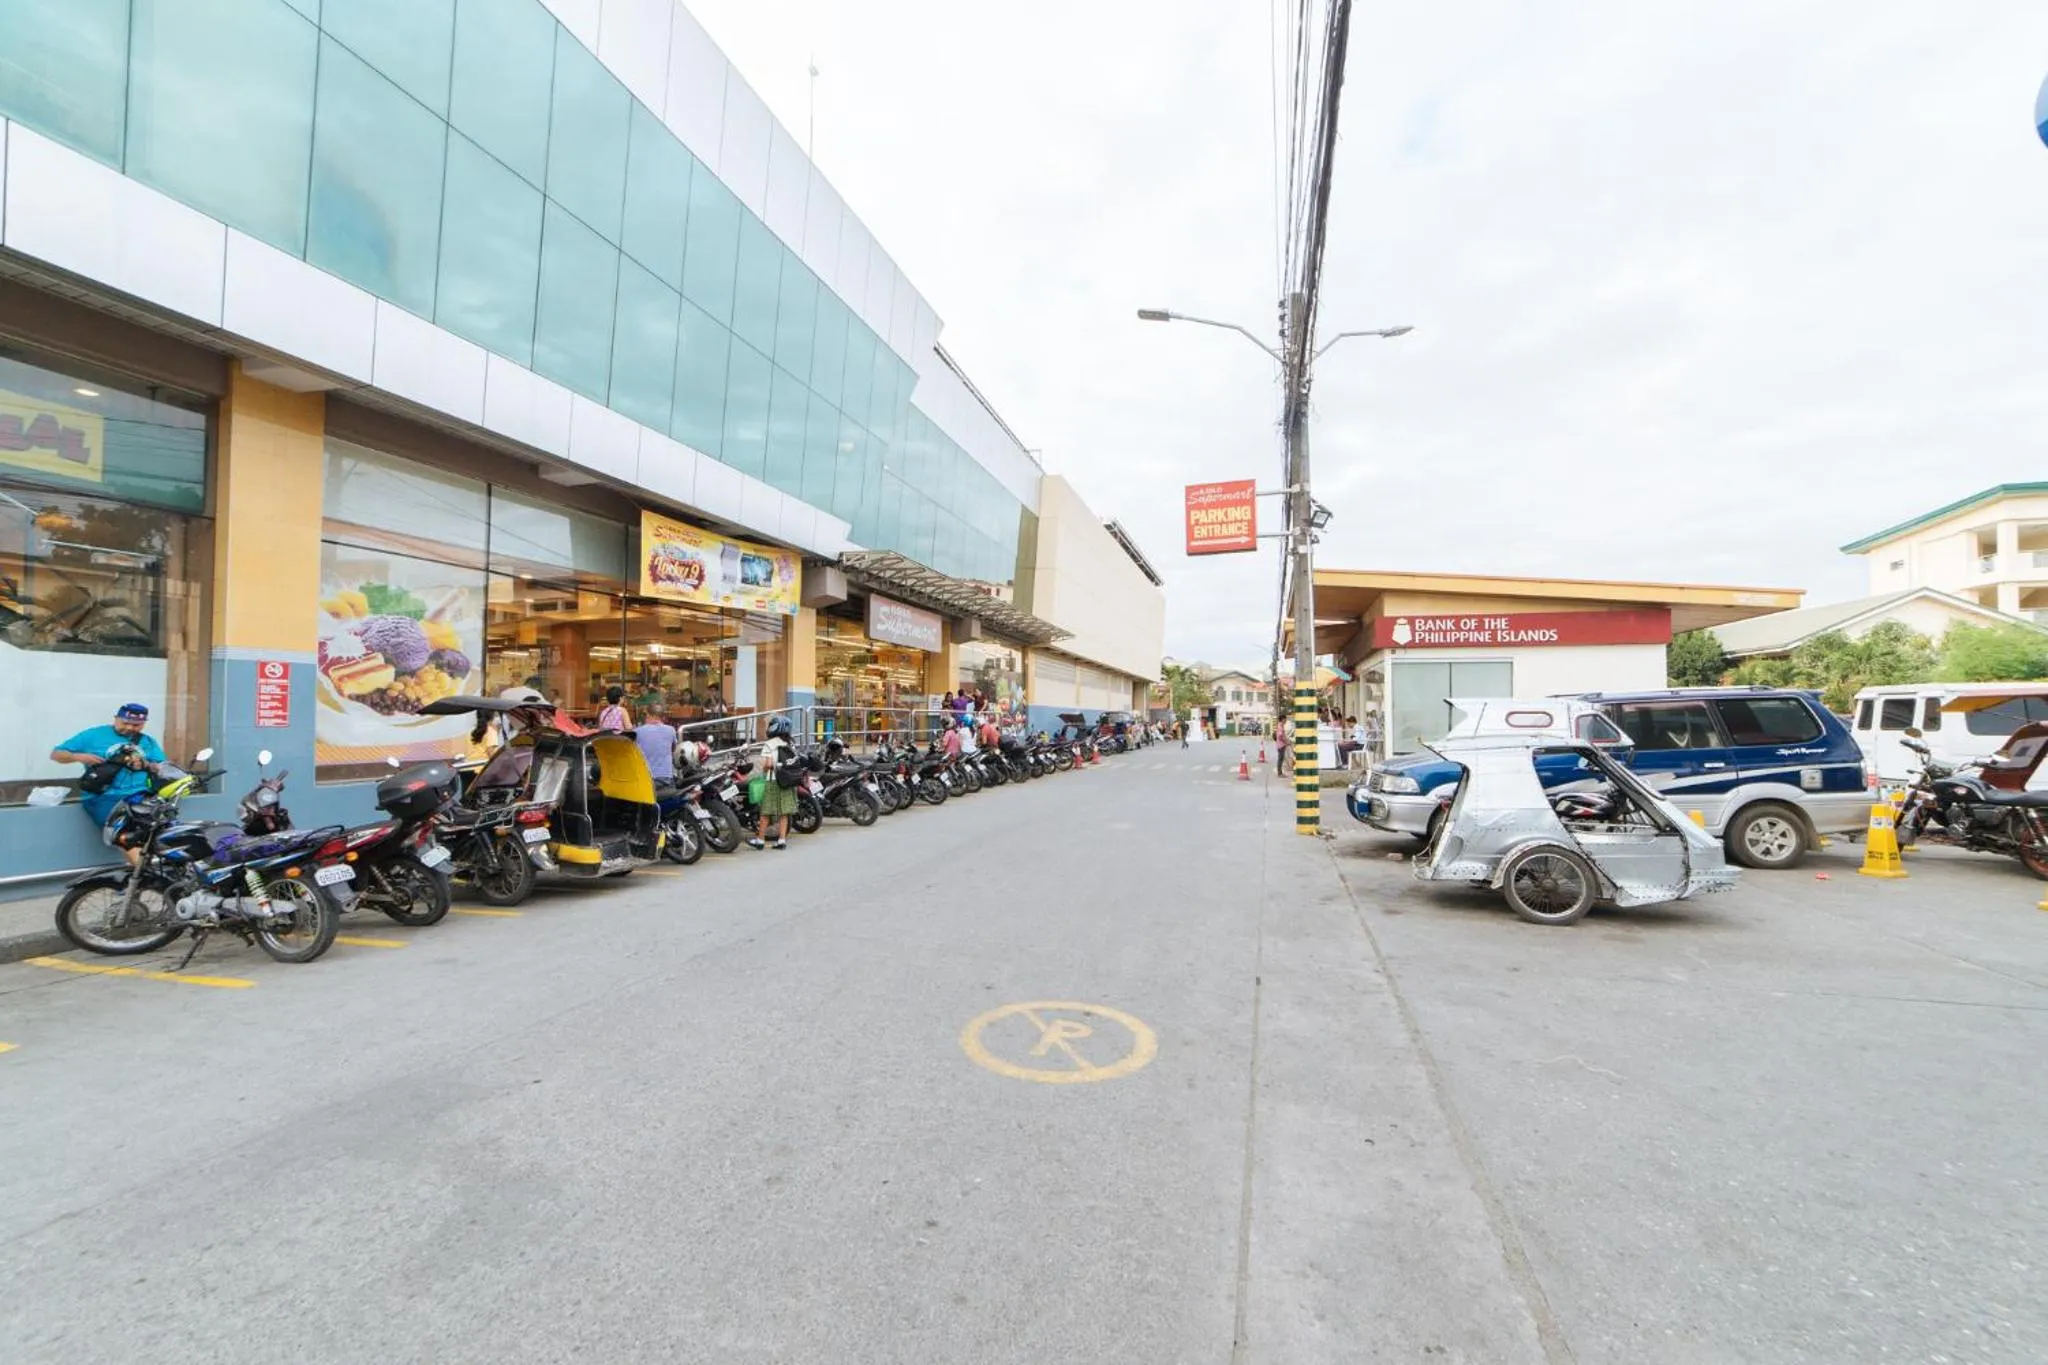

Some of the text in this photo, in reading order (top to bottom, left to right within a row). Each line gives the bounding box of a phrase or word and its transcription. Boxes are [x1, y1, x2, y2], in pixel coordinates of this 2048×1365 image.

[1190, 506, 1252, 525] PARKING
[1194, 522, 1249, 538] ENTRANCE
[1415, 617, 1509, 631] BANK OF THE
[1415, 629, 1558, 644] PHILIPPINE ISLANDS
